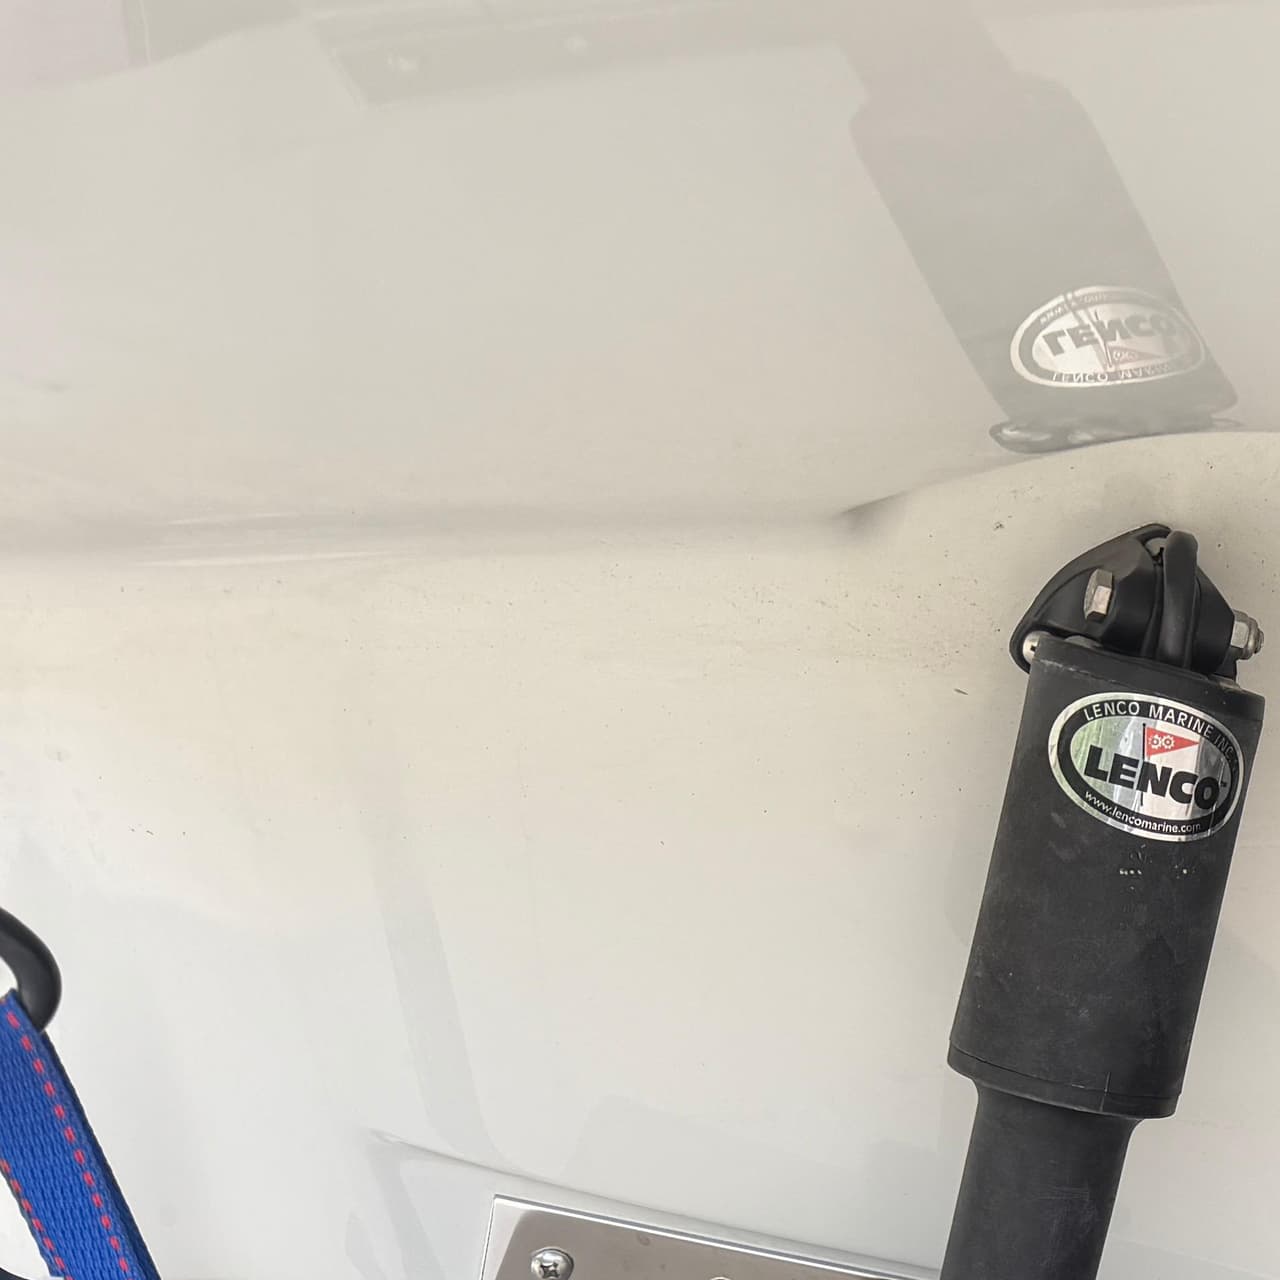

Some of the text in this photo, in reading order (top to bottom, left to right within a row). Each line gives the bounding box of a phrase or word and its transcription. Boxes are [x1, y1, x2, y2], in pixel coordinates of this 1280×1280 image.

[1083, 701, 1140, 721] LENCO
[1149, 703, 1214, 738] MARINE
[1083, 744, 1220, 810] LENCO
[1084, 789, 1201, 834] www.lencomarine.com
